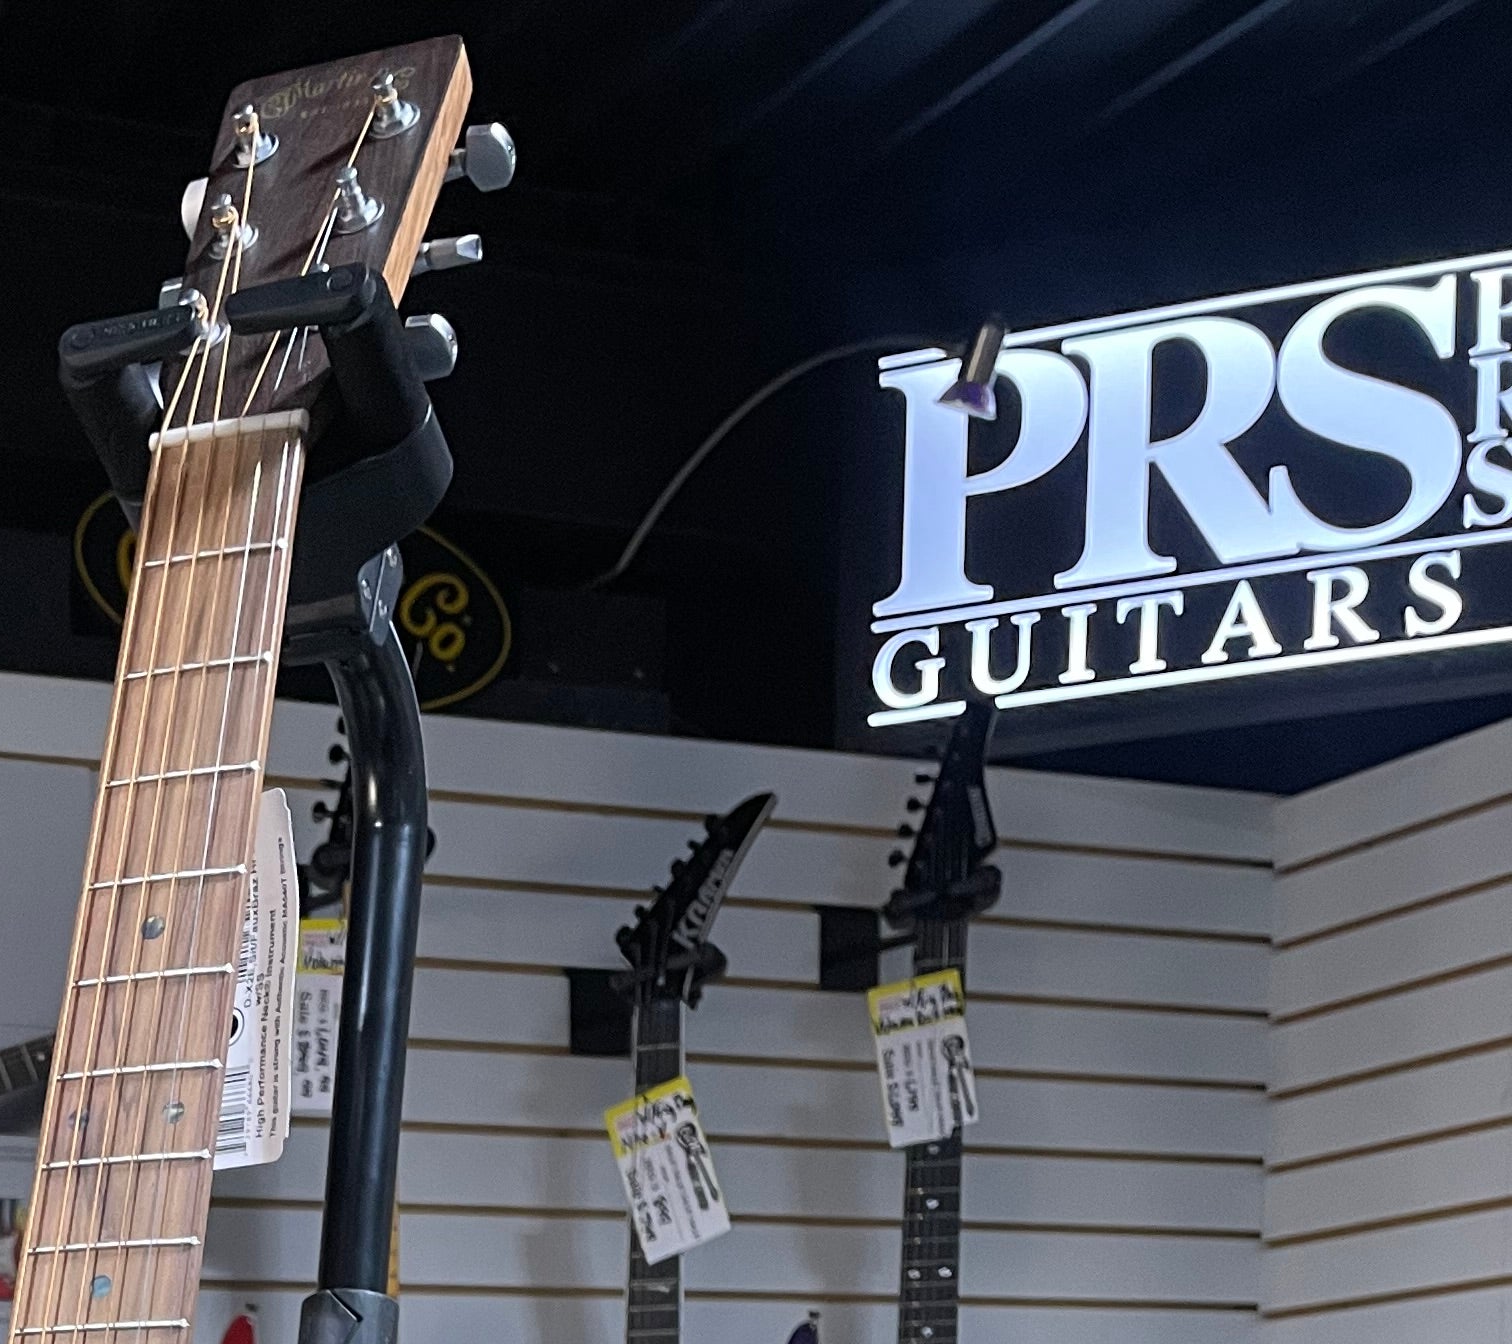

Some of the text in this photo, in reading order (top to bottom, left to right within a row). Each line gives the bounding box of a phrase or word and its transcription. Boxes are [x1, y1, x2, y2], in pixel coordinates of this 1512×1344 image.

[872, 273, 1463, 617] PRS
[871, 549, 1463, 710] GUITARS
[266, 909, 276, 977] Instrument
[257, 1025, 267, 1106] Performance
[255, 1110, 265, 1138] High
